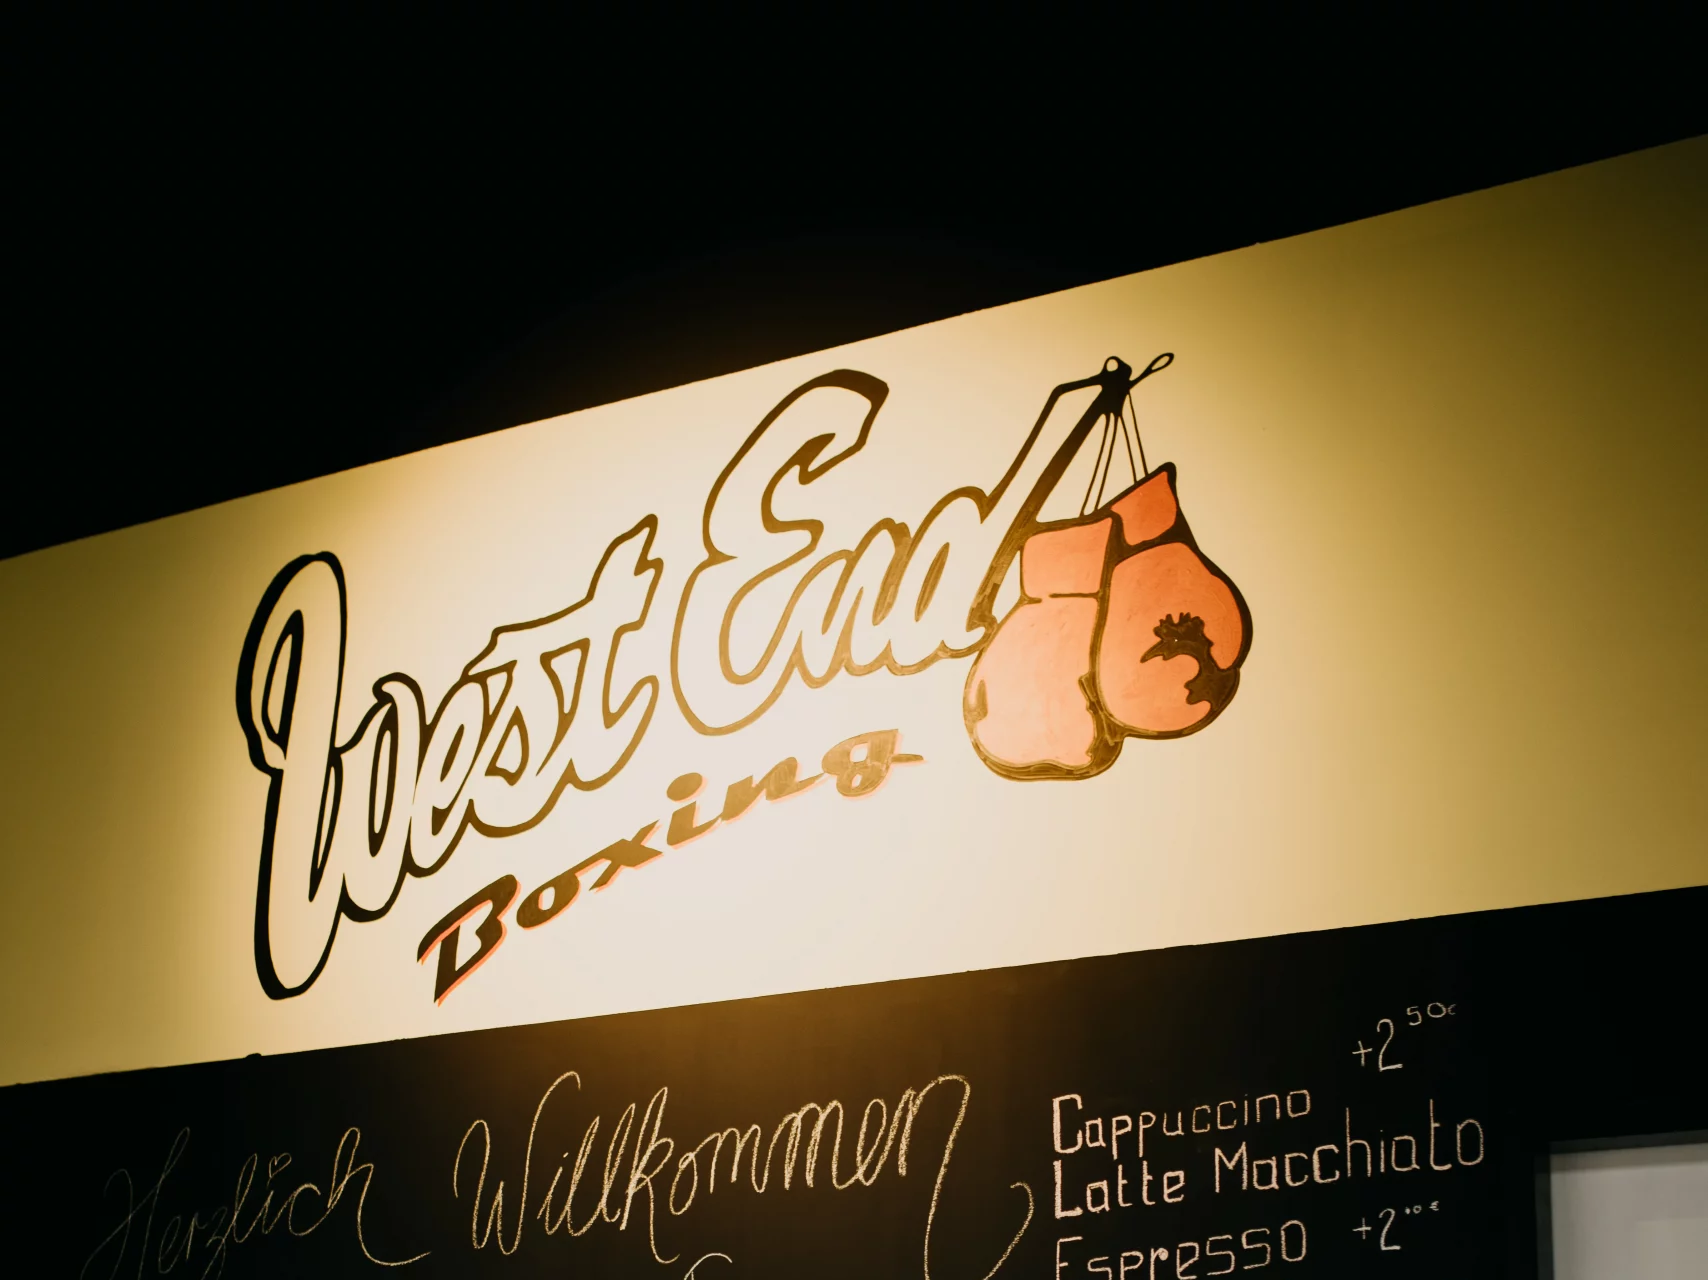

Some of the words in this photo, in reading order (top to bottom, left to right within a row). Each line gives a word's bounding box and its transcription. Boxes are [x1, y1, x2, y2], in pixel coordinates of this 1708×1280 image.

[234, 513, 662, 1000] West
[668, 360, 1132, 736] End
[416, 727, 923, 1004] Boxing
[1052, 1089, 1312, 1160] Cappuccino
[1053, 1159, 1186, 1219] Latte
[1213, 1099, 1485, 1193] Macchiato
